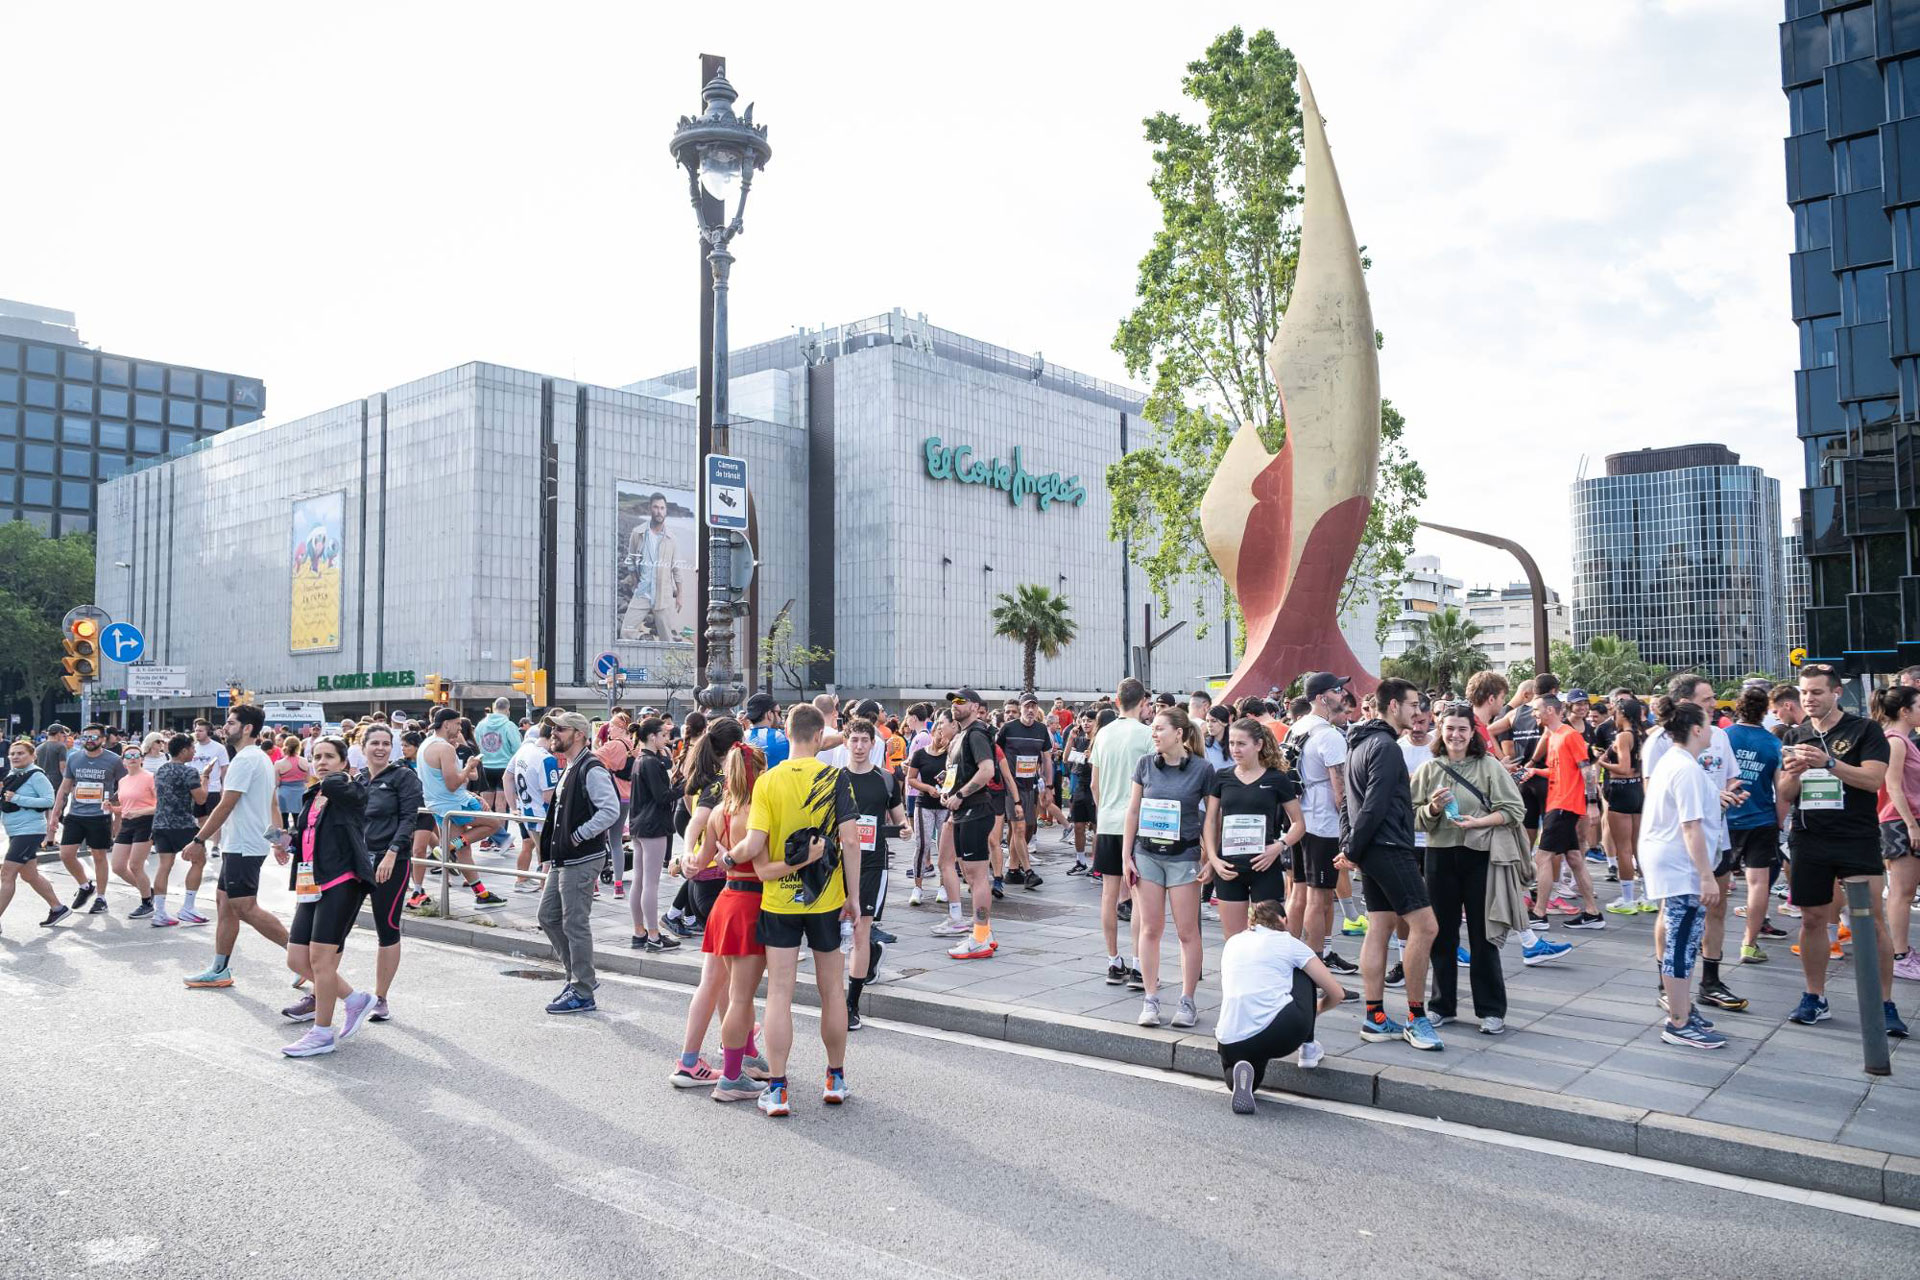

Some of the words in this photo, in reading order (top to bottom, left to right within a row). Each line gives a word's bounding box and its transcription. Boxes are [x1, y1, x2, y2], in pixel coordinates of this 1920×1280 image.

[925, 436, 952, 480] El
[954, 444, 1011, 491] Corte
[1012, 444, 1088, 512] Inglés
[317, 675, 333, 691] EL
[332, 673, 370, 689] CORTE
[1735, 749, 1757, 760] SEMI
[517, 773, 532, 804] 8
